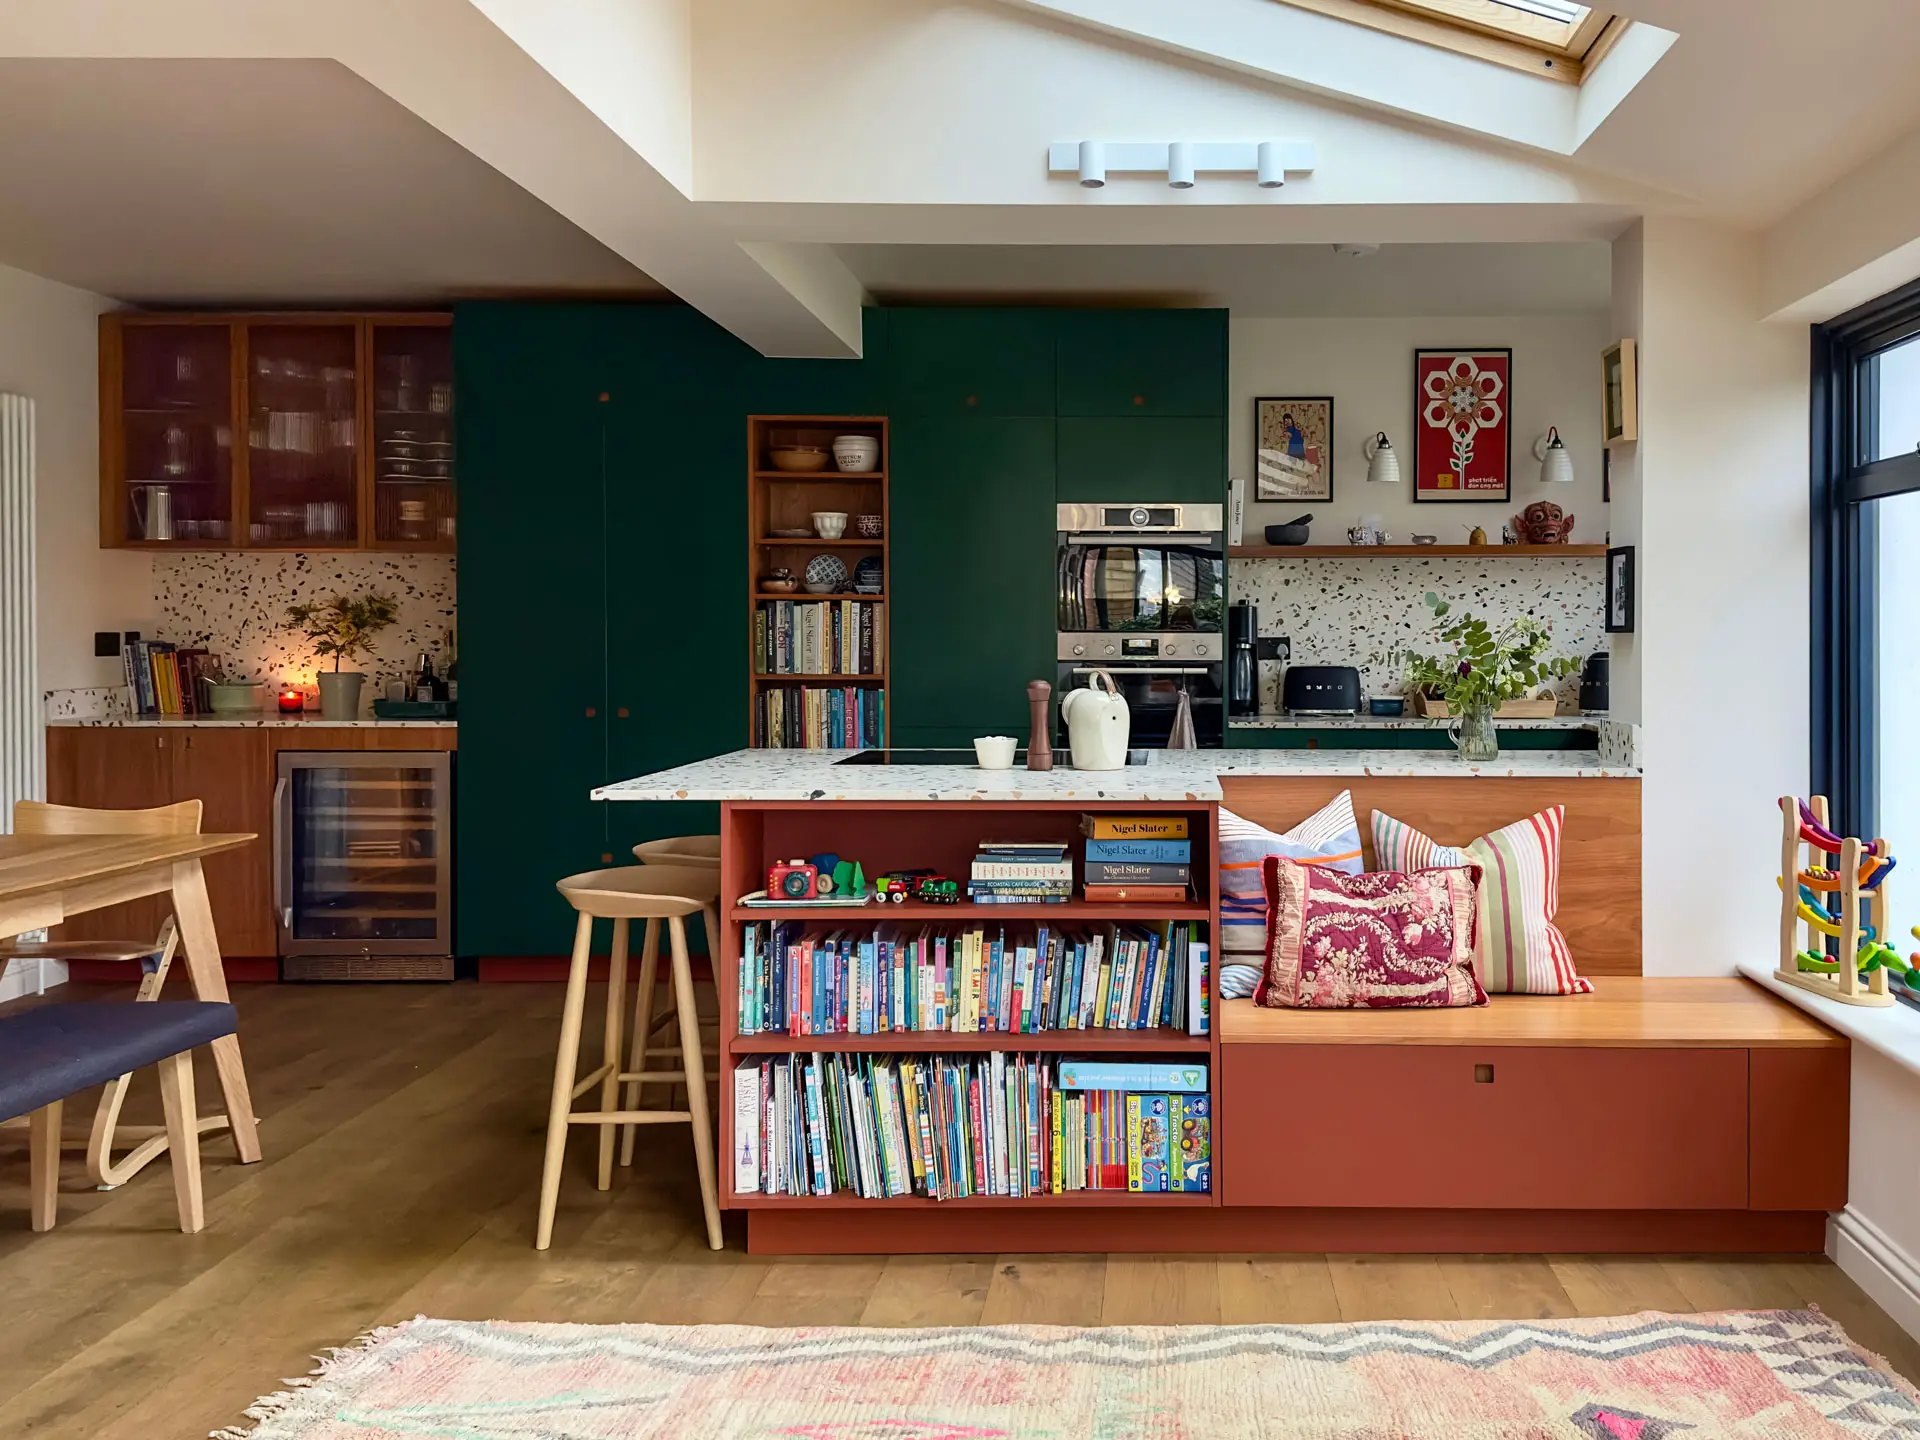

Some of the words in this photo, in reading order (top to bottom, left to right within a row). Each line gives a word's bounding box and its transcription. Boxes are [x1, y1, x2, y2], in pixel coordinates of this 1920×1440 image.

[804, 608, 815, 629] Nigel
[861, 607, 872, 627] Nigel
[777, 626, 785, 649] LEON
[805, 630, 814, 653] Slater
[863, 628, 871, 649] Slater
[1112, 823, 1136, 835] Nigel
[1138, 823, 1168, 833] Slater
[1096, 845, 1120, 856] Nigel
[1121, 845, 1147, 855] Slater
[1103, 865, 1124, 876] Nigel
[1125, 866, 1151, 874] Slater
[928, 883, 934, 891] 7
[972, 968, 981, 1000] ELMER
[743, 1077, 751, 1115] VISUAL
[1128, 1100, 1138, 1114] Big
[1171, 1099, 1179, 1113] Big
[1129, 1115, 1138, 1131] Fire
[1129, 1131, 1138, 1159] Engine
[1161, 1182, 1167, 1190] 20
